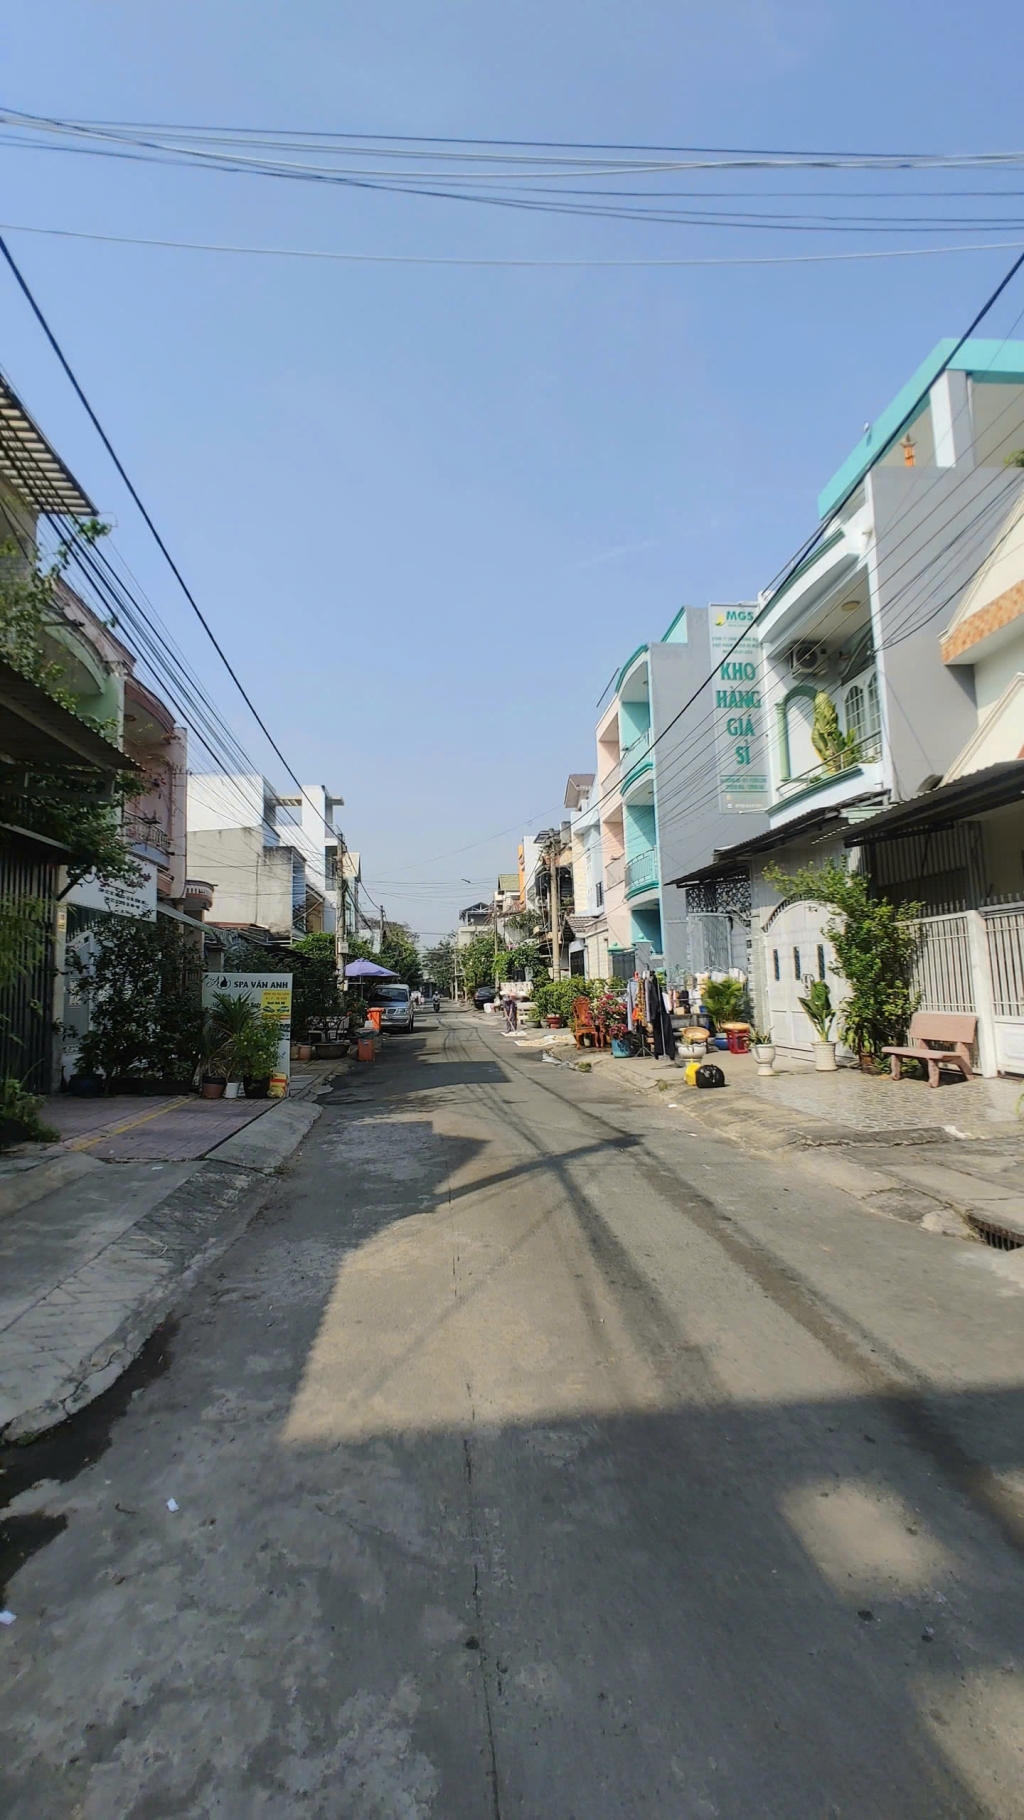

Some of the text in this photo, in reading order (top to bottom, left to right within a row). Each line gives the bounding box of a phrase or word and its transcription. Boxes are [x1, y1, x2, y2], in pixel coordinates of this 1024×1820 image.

[726, 611, 754, 621] MGS
[720, 662, 756, 681] KHO
[716, 686, 761, 708] HÀNG
[726, 713, 755, 737] GIÁ
